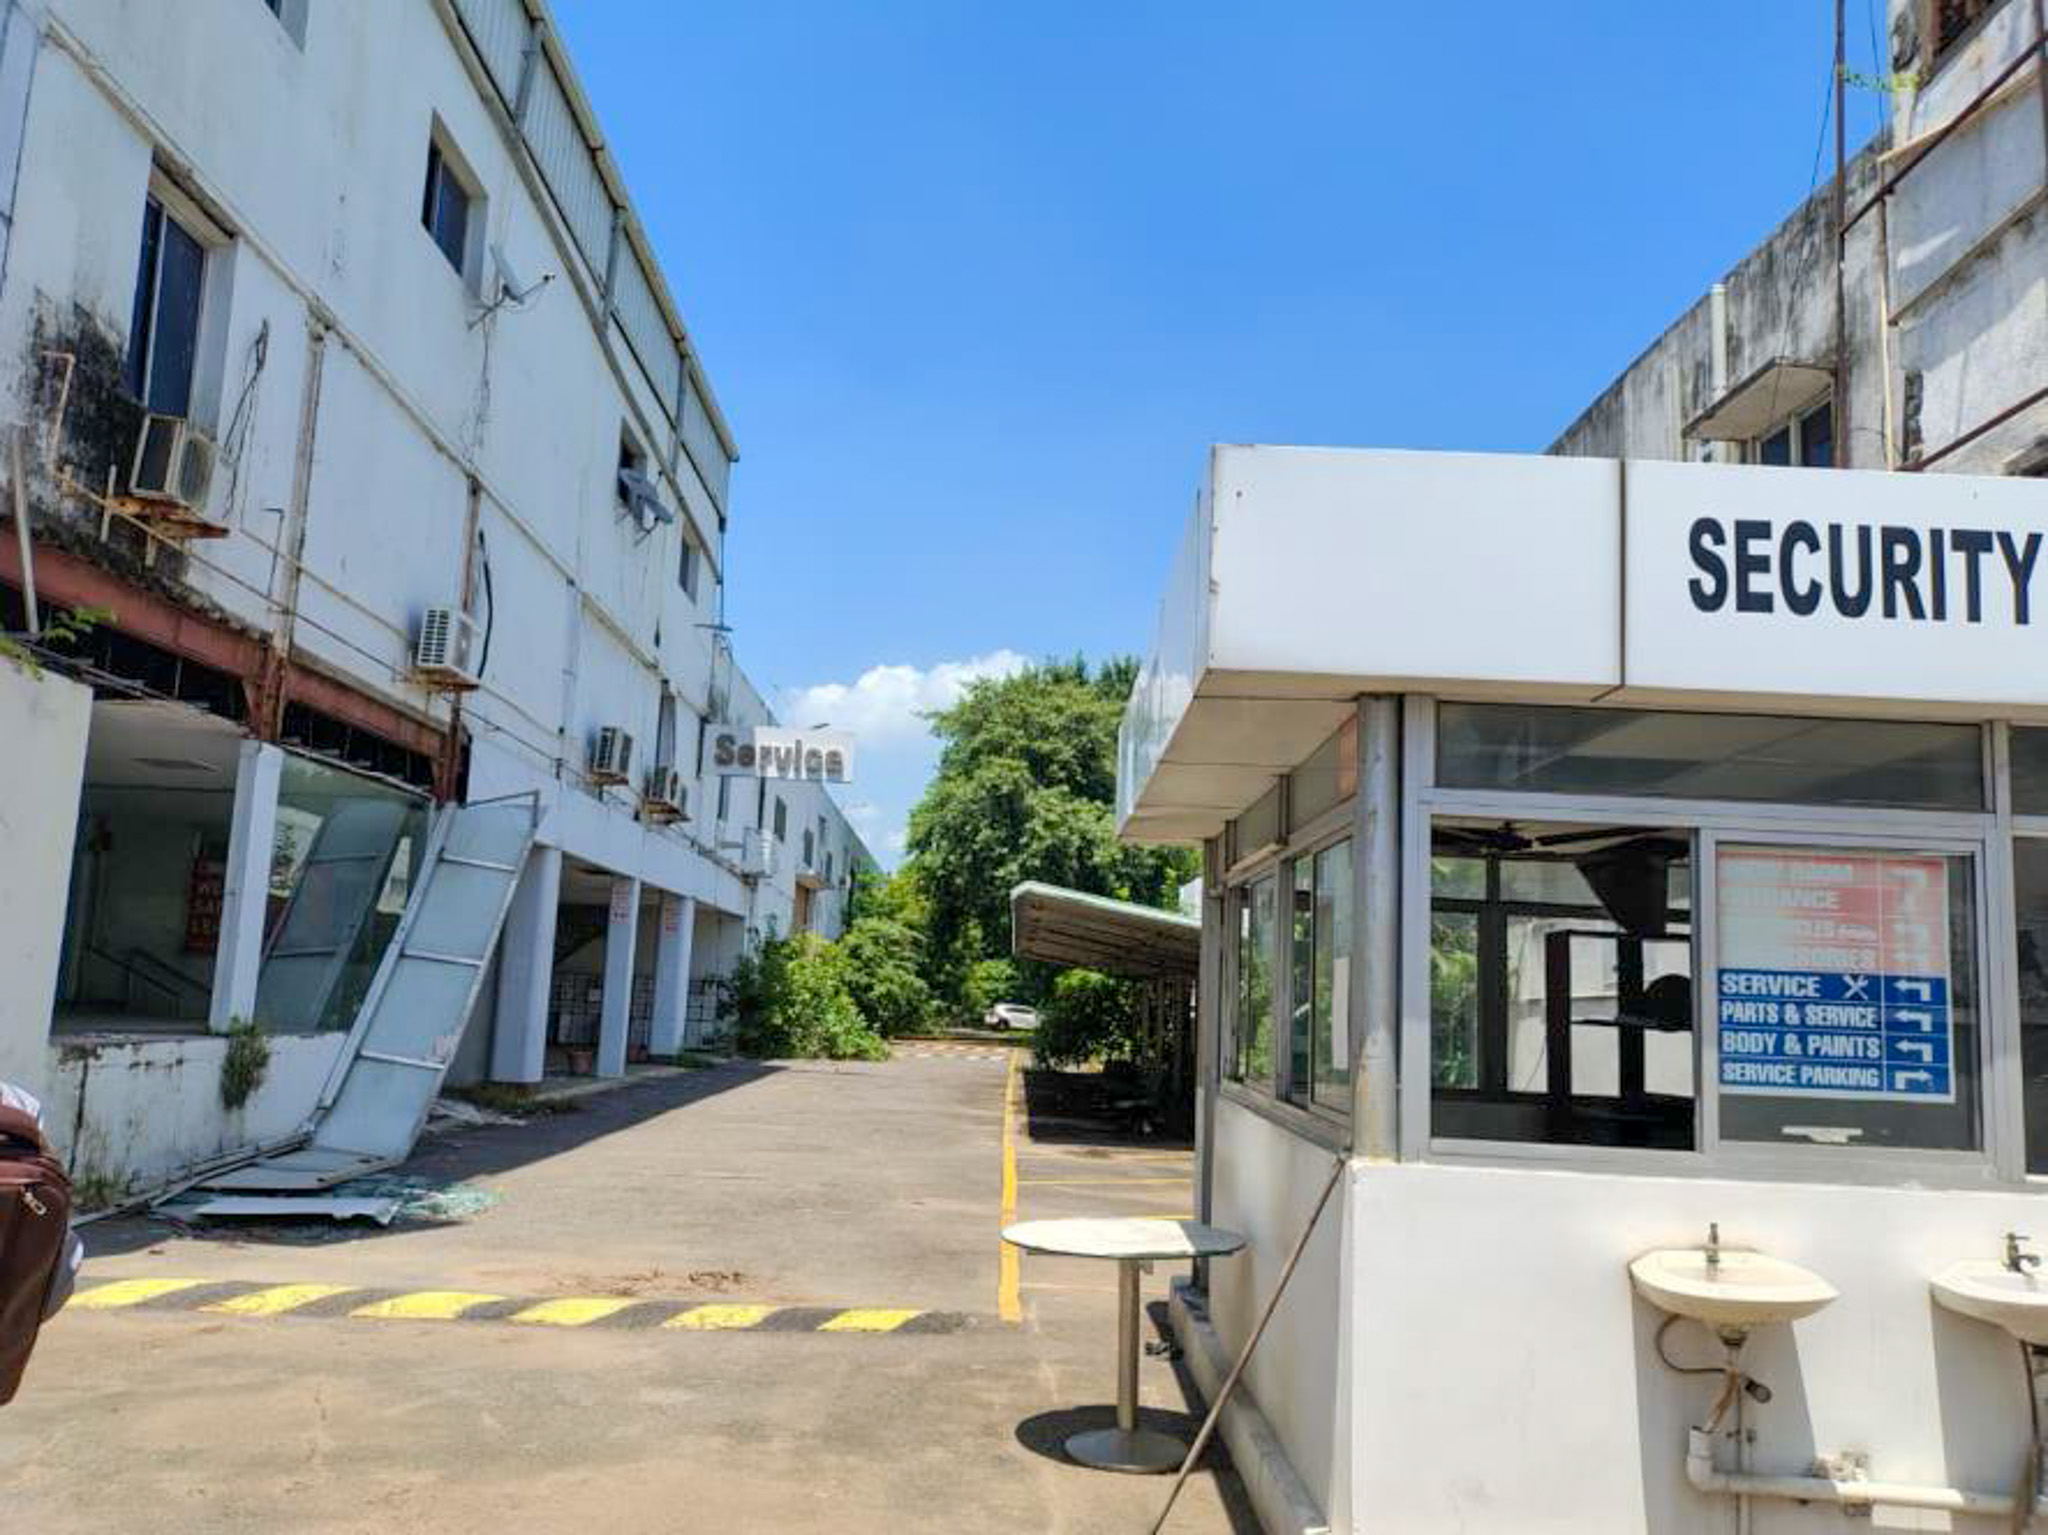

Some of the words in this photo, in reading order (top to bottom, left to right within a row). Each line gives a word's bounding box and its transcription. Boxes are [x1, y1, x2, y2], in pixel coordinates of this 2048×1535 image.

[1688, 517, 2044, 625] SECURITY
[714, 734, 844, 779] Service
[1721, 973, 1821, 998] SERVICE
[1721, 1001, 1778, 1025] PARTS
[1783, 1003, 1801, 1026] &
[1804, 1004, 1877, 1028] SERVICE
[1722, 1031, 1778, 1054] BODY
[1783, 1033, 1802, 1055] &
[1807, 1035, 1881, 1059] PAINTS
[1722, 1063, 1796, 1084] SERVICE
[1801, 1066, 1880, 1088] PARKING
